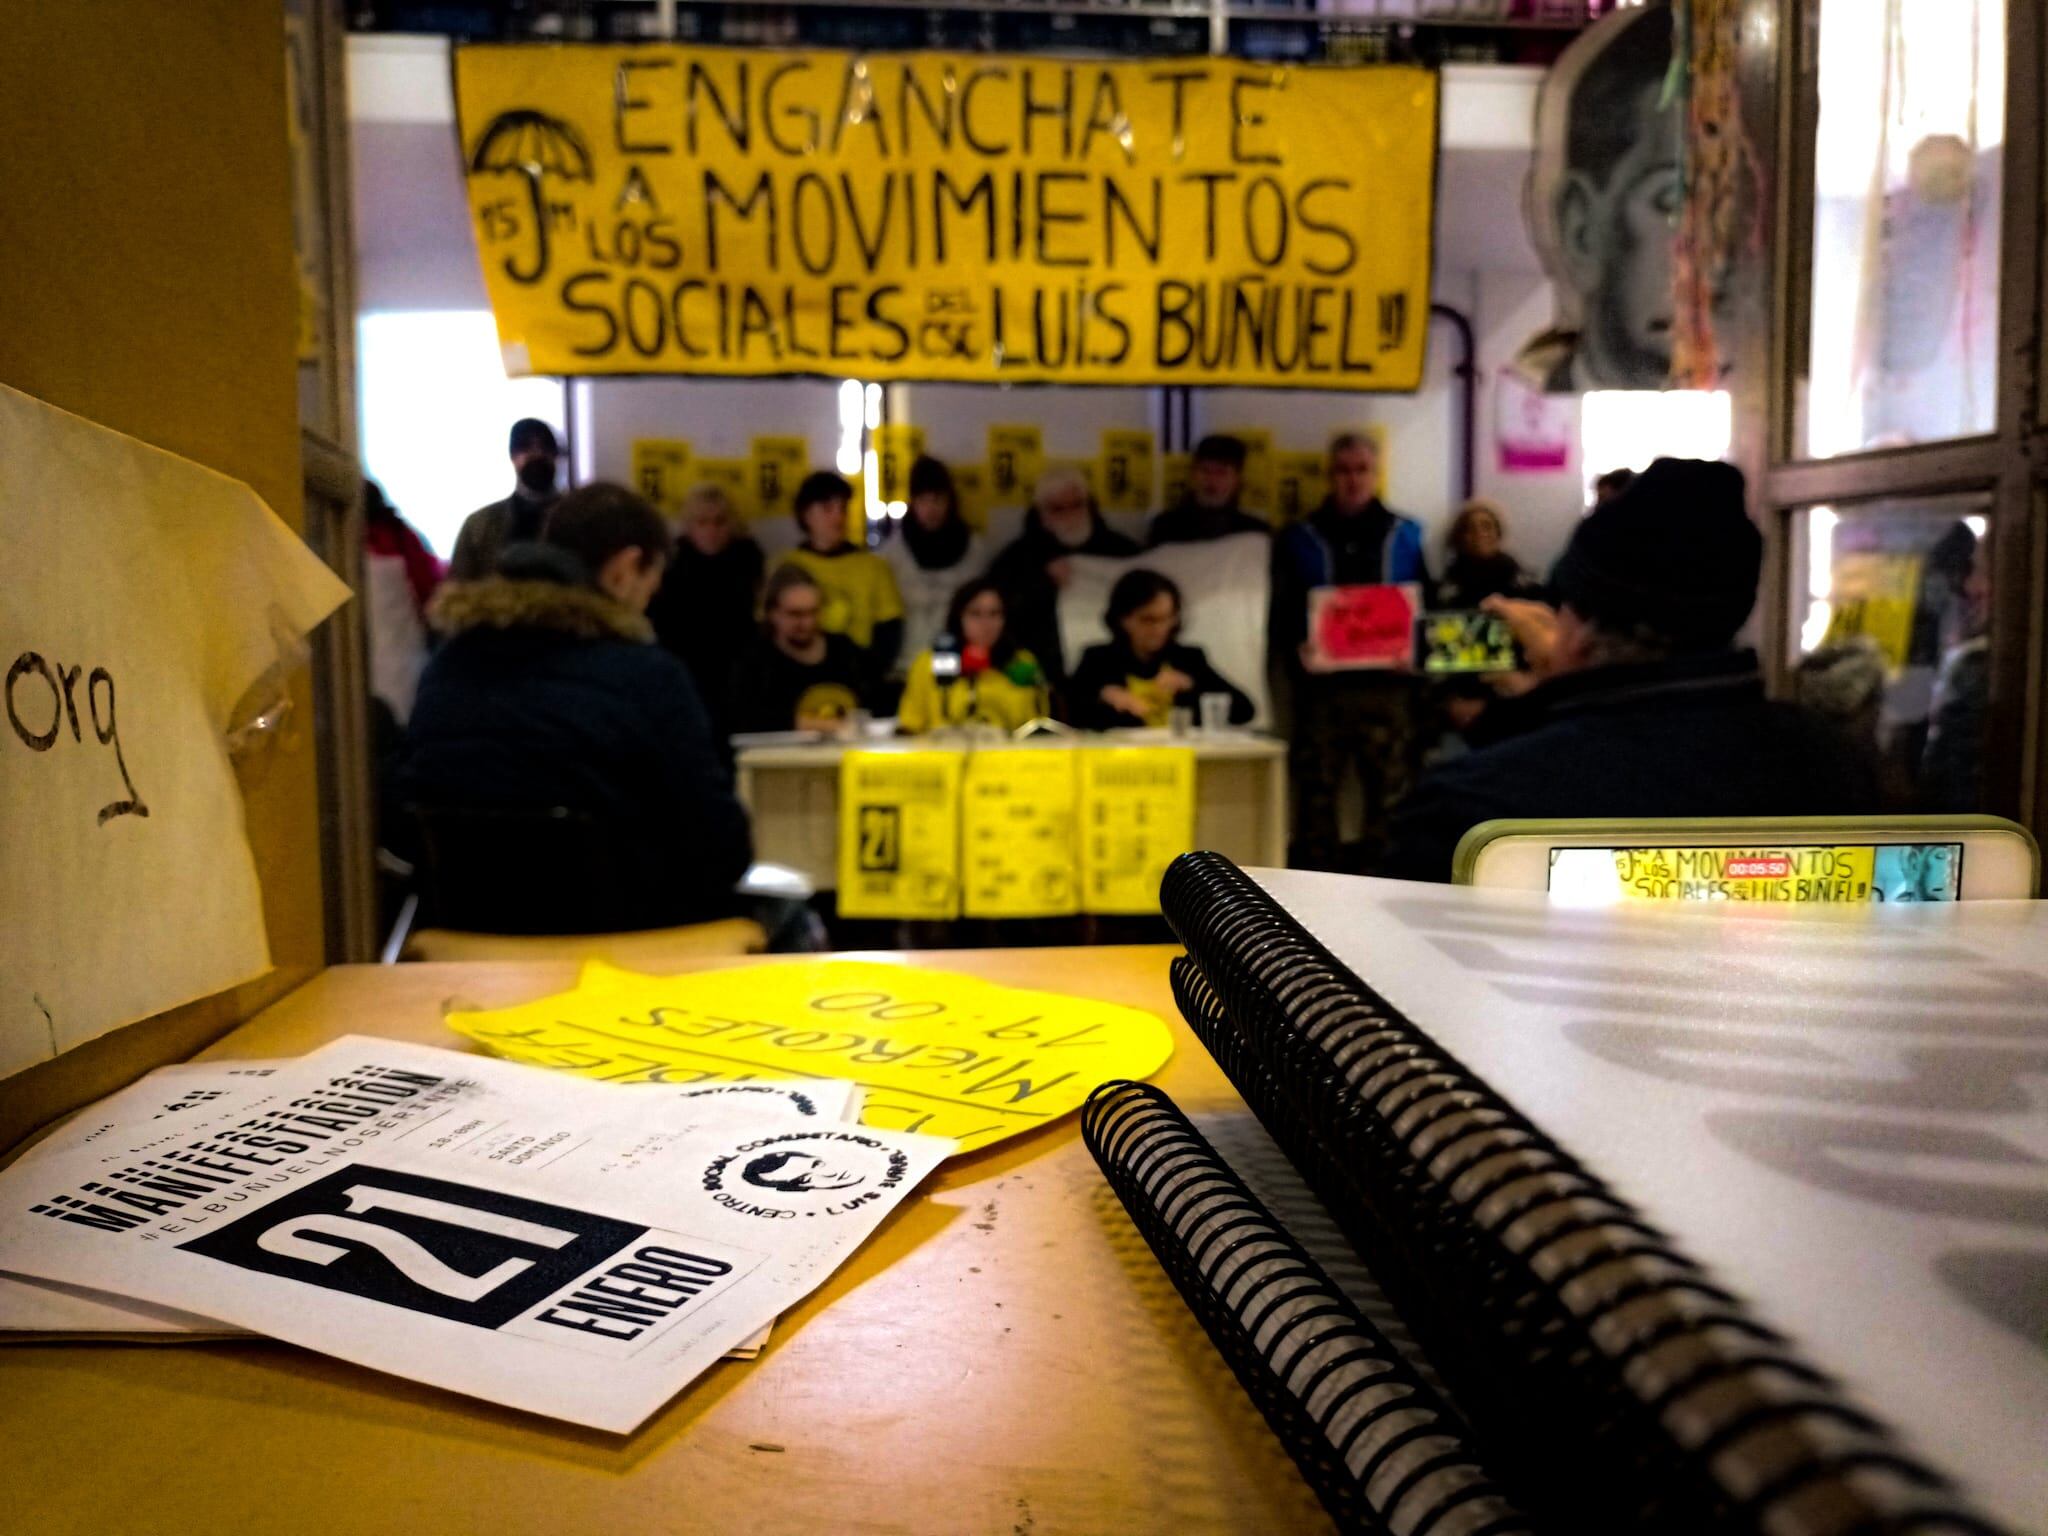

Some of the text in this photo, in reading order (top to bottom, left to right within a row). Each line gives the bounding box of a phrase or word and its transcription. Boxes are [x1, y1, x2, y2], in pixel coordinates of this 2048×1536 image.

[616, 165, 660, 212] A
[586, 168, 1357, 277] LOS MOVIMIENTOS
[561, 272, 911, 361] SOCIALES
[1728, 863, 1786, 875] 00:05:50
[489, 1136, 536, 1161] SANTO
[508, 1131, 571, 1165] DOMINGO
[713, 1192, 797, 1220] CENTRO
[256, 1183, 579, 1303] 21
[534, 1245, 734, 1342] ENERO
